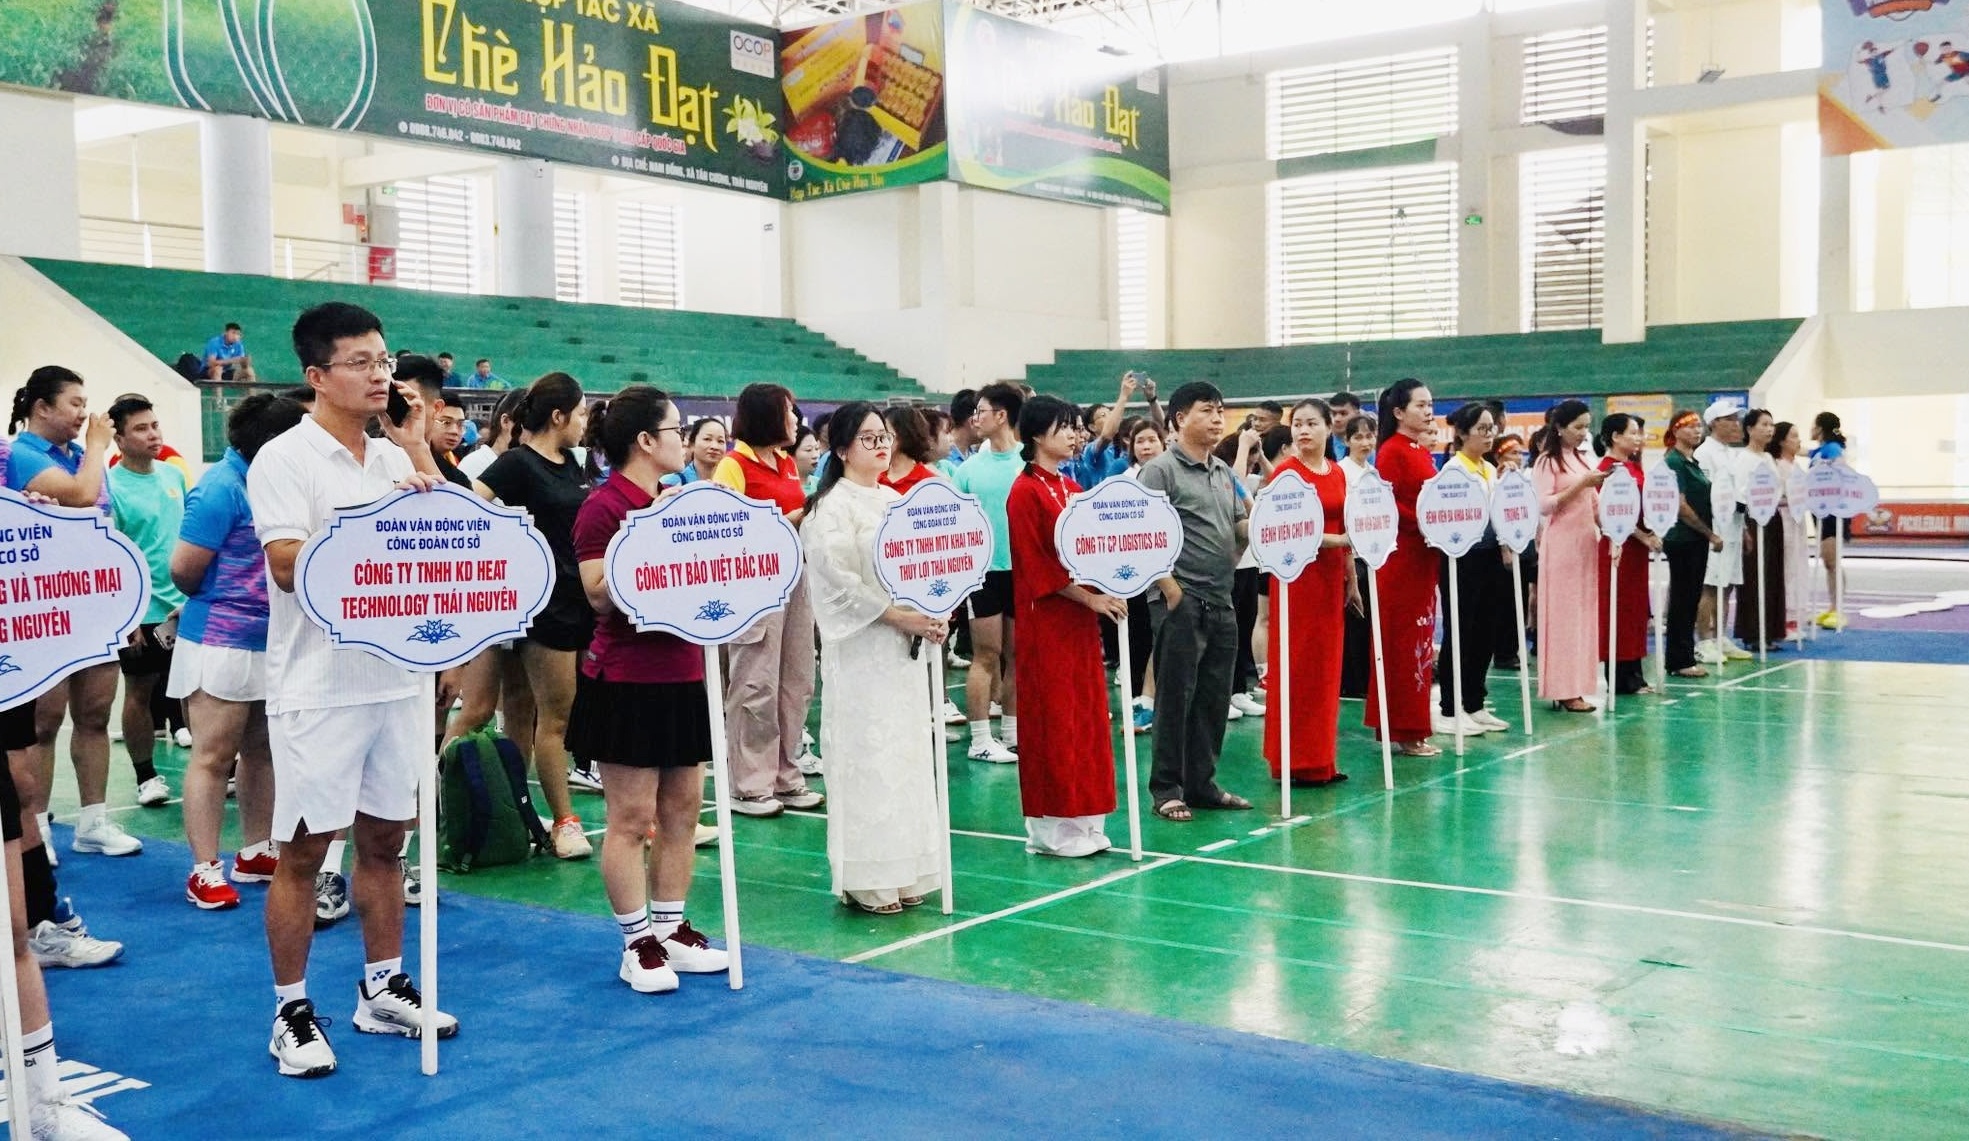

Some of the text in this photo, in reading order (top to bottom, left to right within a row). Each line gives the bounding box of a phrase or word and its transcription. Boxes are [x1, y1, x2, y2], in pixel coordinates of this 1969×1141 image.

[627, 1, 659, 34] XÃ
[734, 35, 771, 57] OCOP
[422, 0, 720, 153] Chè Hảo Đạt
[425, 93, 447, 112] ĐƠN
[459, 97, 471, 117] CÓ
[1101, 85, 1141, 150] Đạt
[18, 523, 53, 541] VIÊN
[376, 518, 491, 535] ĐOÀN VẬN ĐỘNG VIÊN
[662, 510, 750, 528] ĐOÀN VẬN ĐỘNG VIÊN
[387, 534, 481, 550] CÔNG ĐOÀN CƠ SỞ
[672, 524, 744, 543] CÔNG ĐOÀN CƠ SỞ
[884, 527, 984, 559] CÔNG TY TNHH MTV KHAI THÁC
[1075, 534, 1096, 555] CÔNG
[1097, 536, 1106, 553] TY
[1107, 535, 1117, 553] CP
[1118, 532, 1153, 552] LOGISTICS
[21, 543, 40, 562] SỞ
[918, 562, 930, 581] LỢI
[931, 556, 946, 576] THÁI
[947, 552, 974, 573] NGUYÊN
[354, 558, 507, 586] CÔNG TY TNHH KD HEAT
[635, 547, 780, 592] CÔNG TY BẢO VIỆT BẮC KẠN
[11, 571, 31, 603] VÀ
[34, 569, 91, 600] THƯƠNG
[94, 567, 122, 598] MẠI
[341, 586, 517, 619] TECHNOLOGY THÁI NGUYÊN
[12, 606, 71, 641] NGUYÊN
